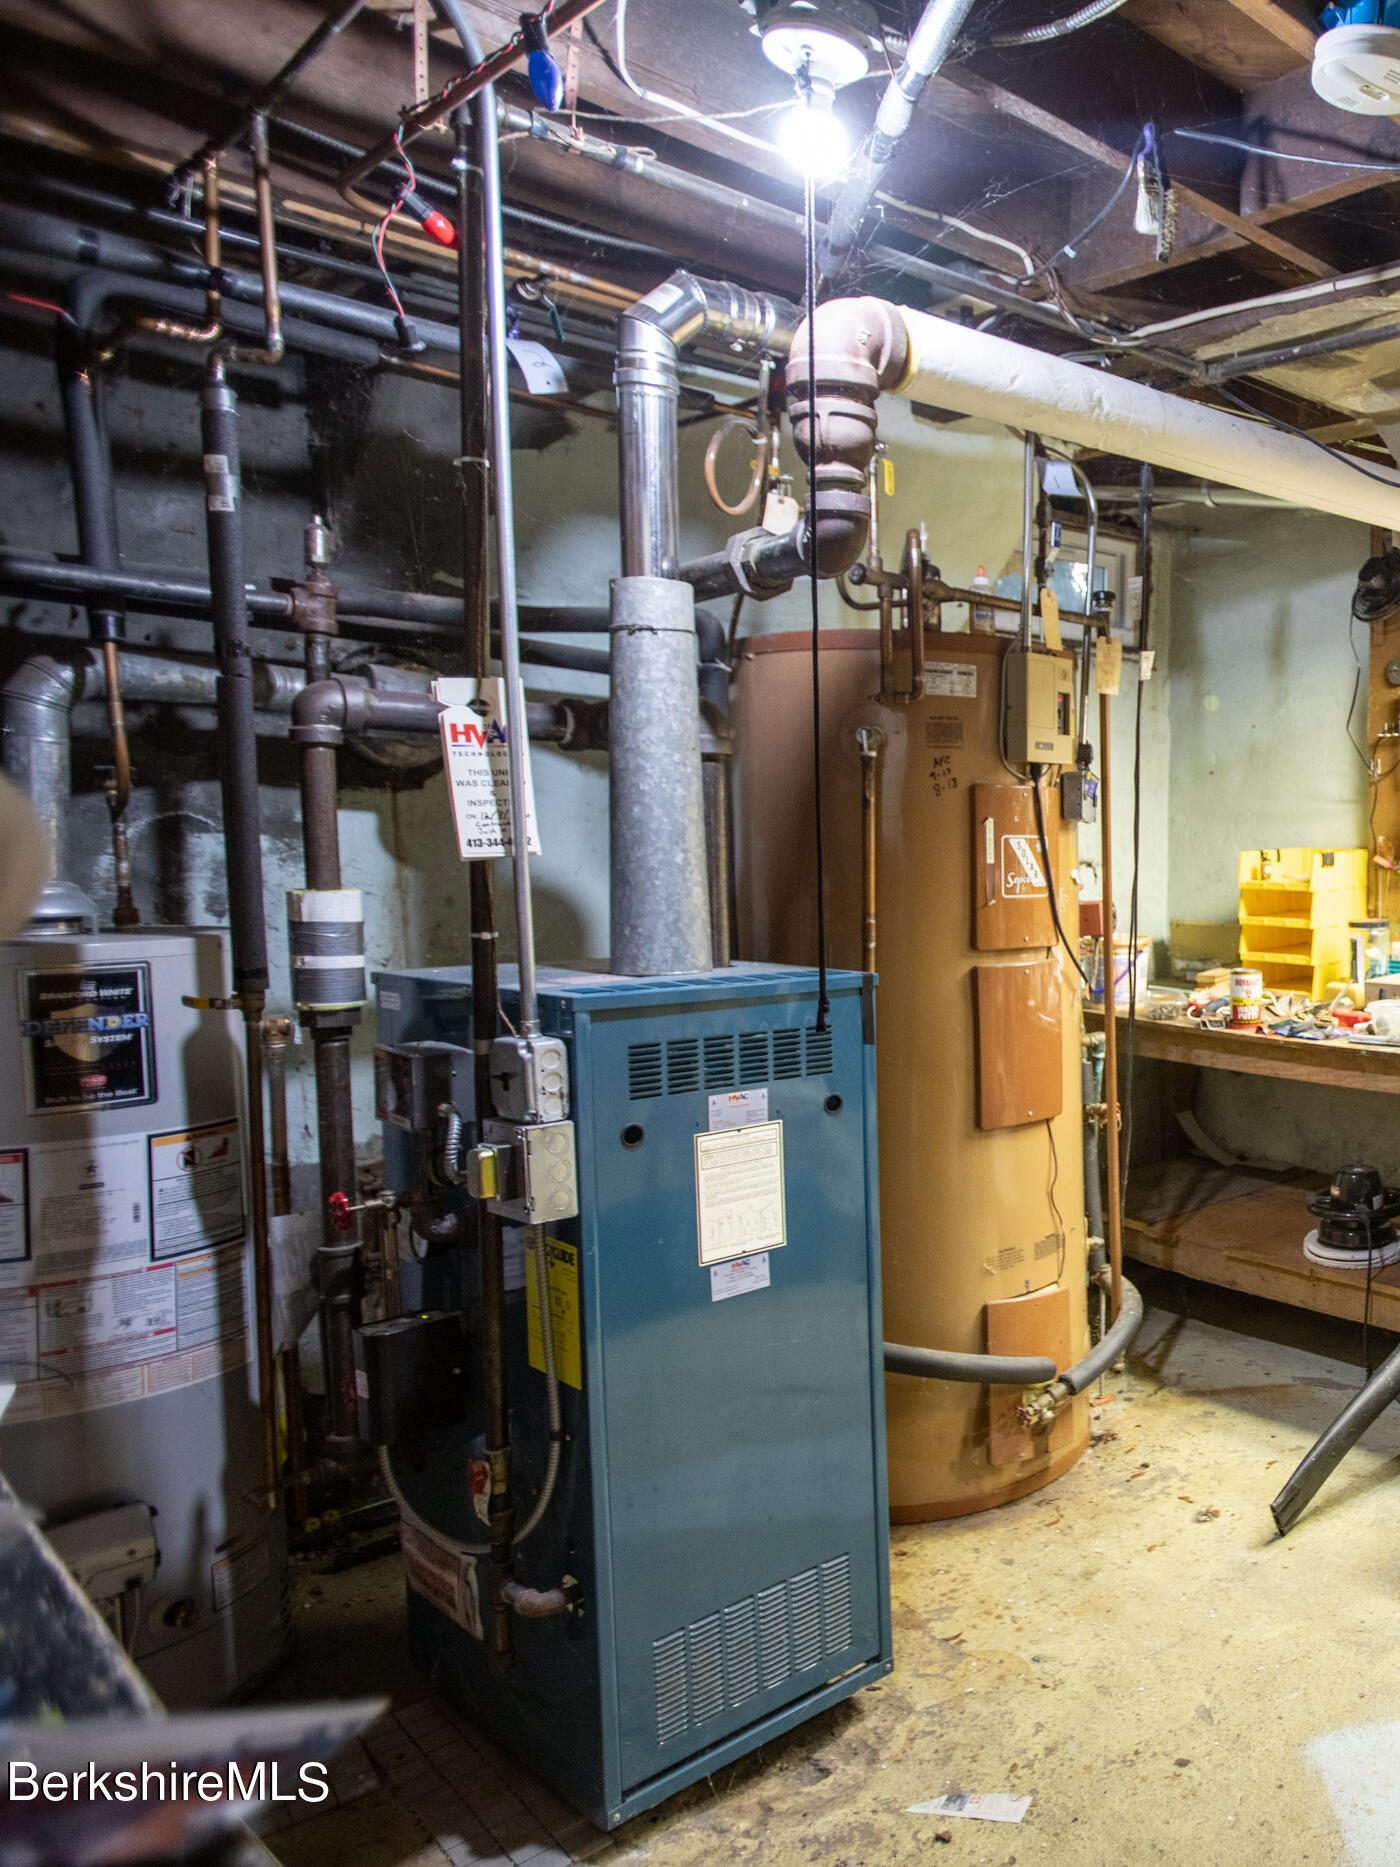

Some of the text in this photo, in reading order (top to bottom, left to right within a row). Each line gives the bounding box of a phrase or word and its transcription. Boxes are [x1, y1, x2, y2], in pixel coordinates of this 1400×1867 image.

[449, 719, 508, 750] HVA
[467, 768, 508, 776] THIS UNI
[467, 799, 509, 807] INSPECT
[466, 837, 532, 848] 413-344-42
[22, 1012, 150, 1037] DEFENDER
